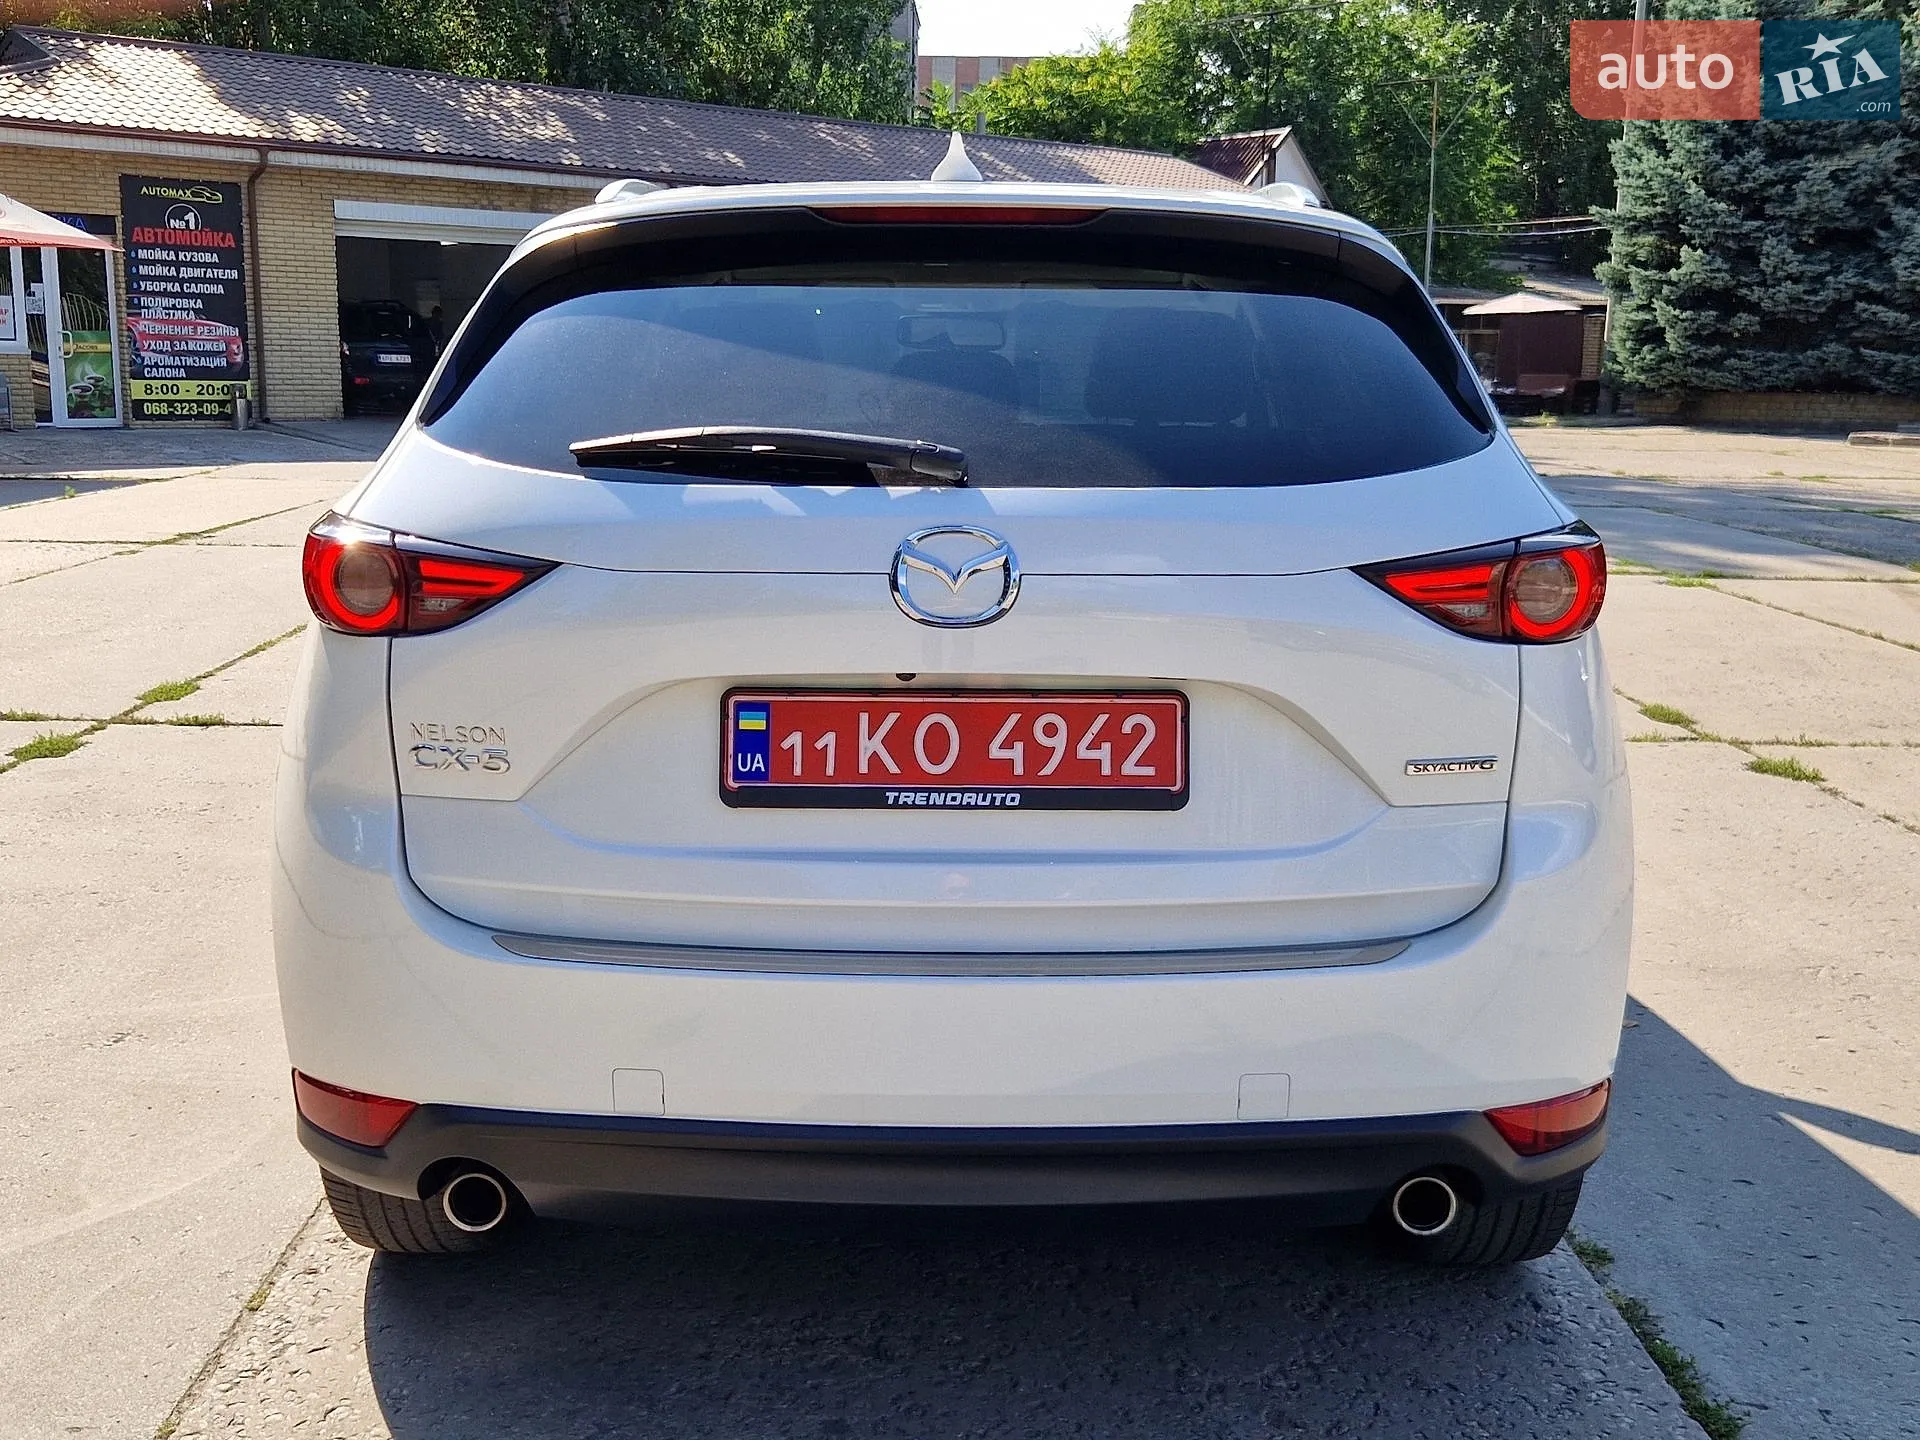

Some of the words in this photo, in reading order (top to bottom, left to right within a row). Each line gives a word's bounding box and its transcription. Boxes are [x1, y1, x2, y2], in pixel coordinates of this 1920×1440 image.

[140, 186, 192, 198] AUTOMAX
[131, 227, 236, 248] АВТОМОЙКА
[138, 248, 176, 261] МОЙКА
[179, 251, 219, 263] КУЗОВА
[139, 264, 177, 277] МОЙКА
[179, 267, 239, 280] ДВИГАТЕЛЯ
[139, 280, 180, 293] УБОРКА
[183, 283, 224, 295] САЛОНА
[141, 297, 203, 309] ПОЛИРОВКА
[141, 309, 196, 320] ПЛАСТИКА
[142, 323, 195, 335] ЧЕРНЕНИЕ
[197, 325, 239, 337] РЕЗИНЫ
[143, 340, 171, 352] УХОД
[173, 340, 186, 351] ЗА
[188, 339, 226, 352] КОЖЕЙ
[143, 356, 227, 368] АРОМАТИЗАЦИЯ
[144, 367, 186, 378] САЛОНА
[144, 383, 180, 396] 8:00
[196, 383, 231, 396] 20:0
[143, 402, 232, 415] 068-323-09-4
[410, 722, 506, 745] NELSON
[779, 731, 836, 777] 11
[987, 712, 1157, 777] 4942
[409, 744, 511, 774] CX-5
[737, 753, 765, 773] UA
